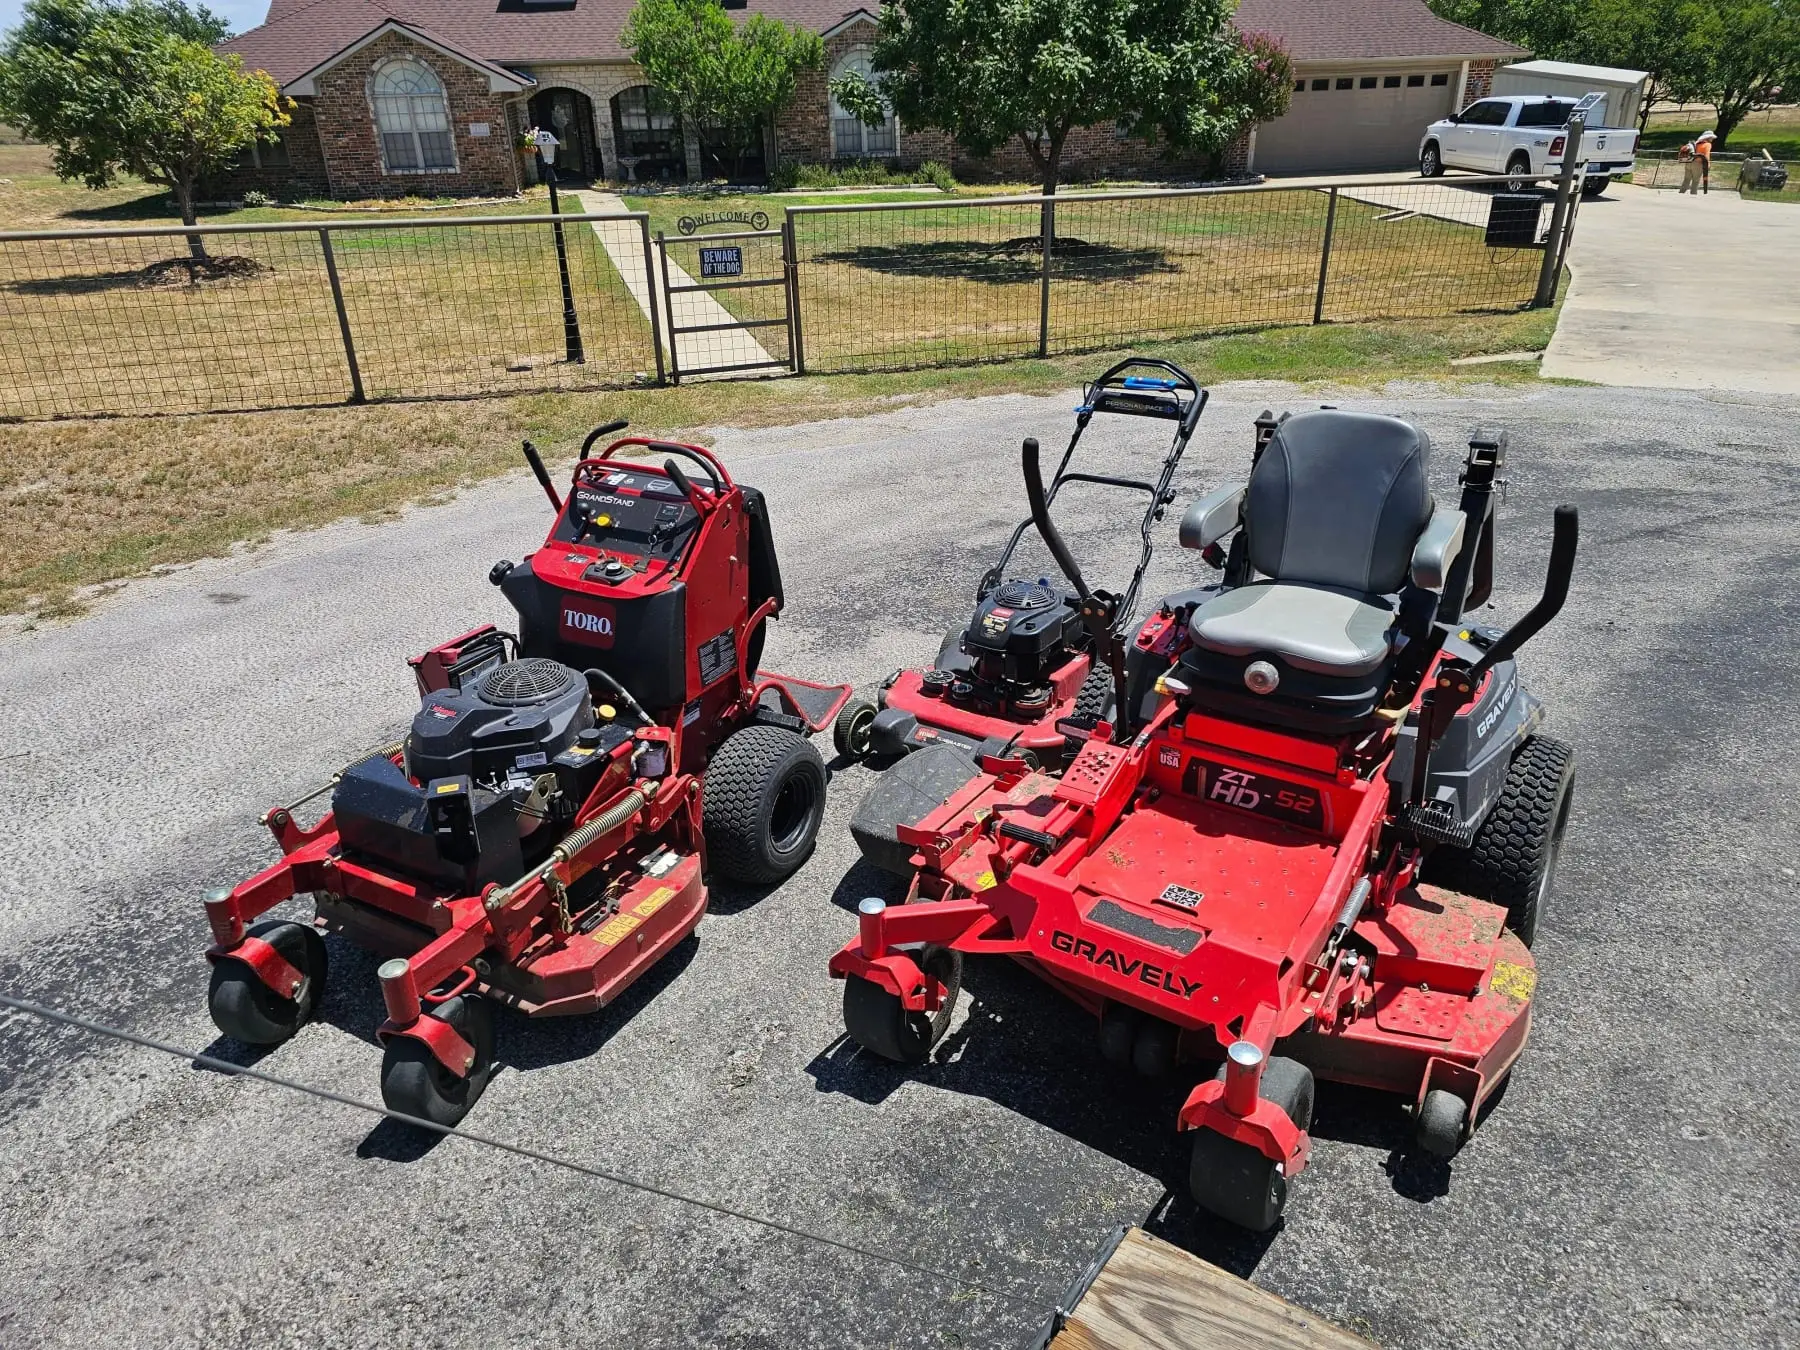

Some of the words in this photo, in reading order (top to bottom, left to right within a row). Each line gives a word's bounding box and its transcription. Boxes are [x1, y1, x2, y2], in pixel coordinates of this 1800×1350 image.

[694, 211, 750, 226] WELCOME
[703, 249, 739, 263] BEWARE
[703, 263, 712, 274] OF
[714, 262, 726, 274] THE
[727, 261, 740, 273] DOG
[1105, 400, 1143, 410] PERSONAL
[1145, 404, 1164, 412] PACE
[1476, 673, 1516, 739] GRAVELY
[1160, 753, 1179, 768] USA
[1221, 767, 1256, 787] ZT
[1051, 929, 1204, 1000] GRAVELY
